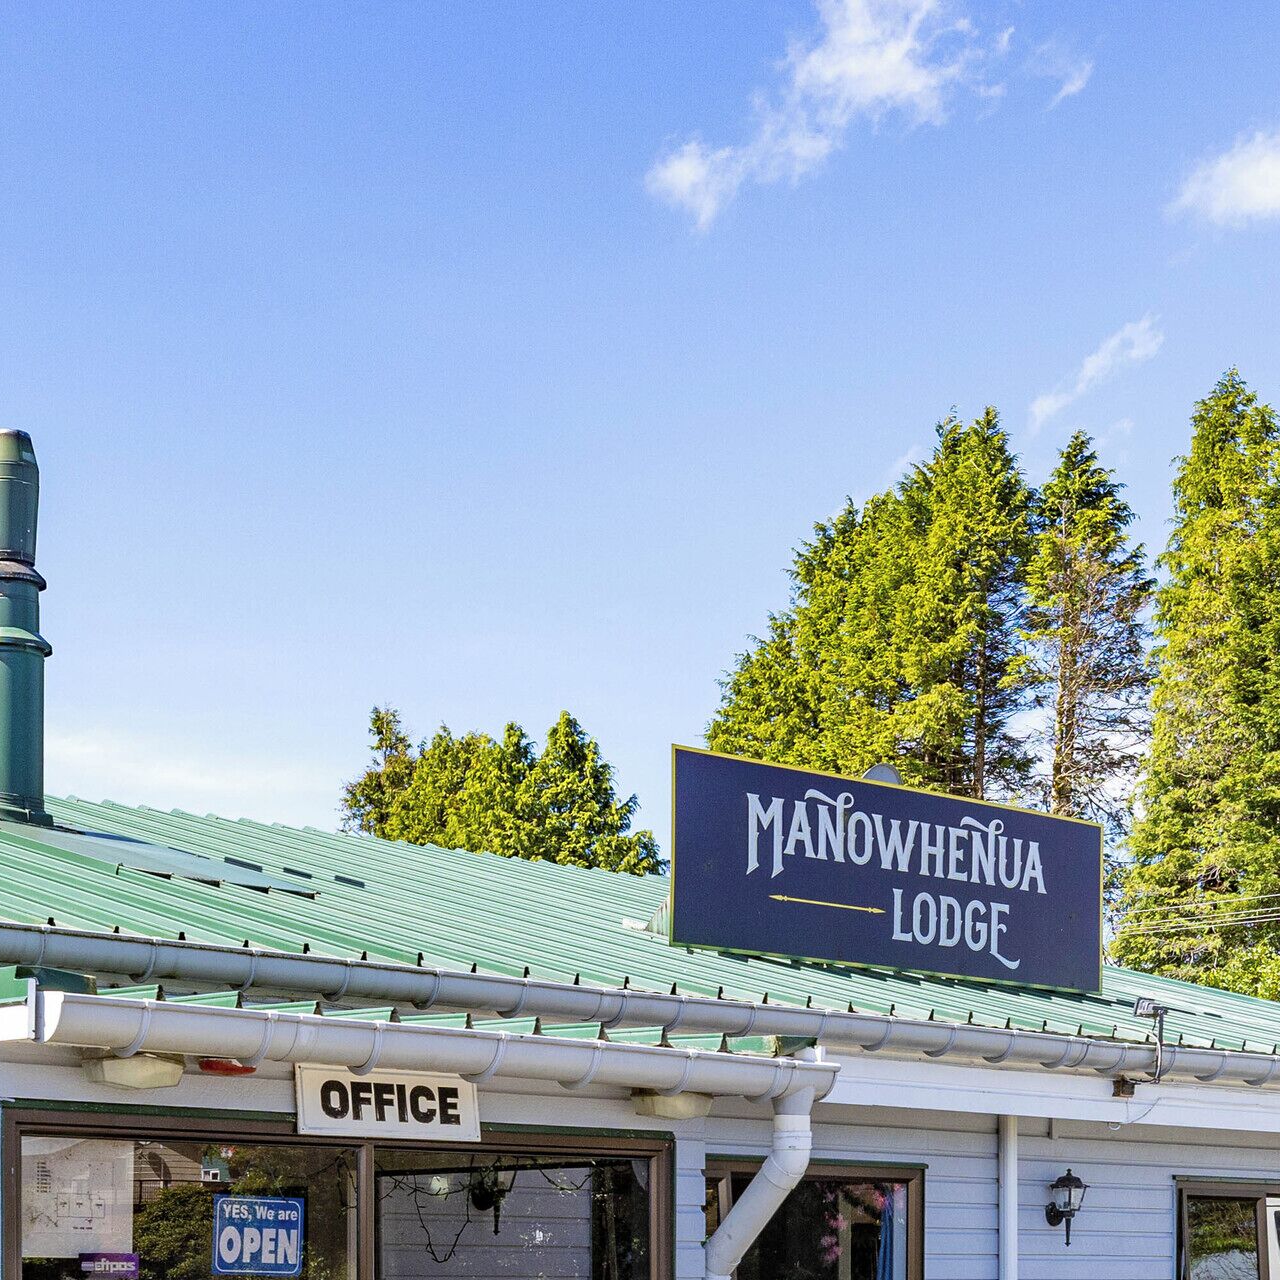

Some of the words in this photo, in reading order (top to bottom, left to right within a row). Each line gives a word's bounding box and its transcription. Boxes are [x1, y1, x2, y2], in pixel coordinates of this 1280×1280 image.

[746, 788, 1047, 895] MANOWHENUA
[891, 888, 1020, 970] LODGE
[320, 1079, 461, 1125] OFFICE
[223, 1204, 252, 1222] YES,
[255, 1206, 273, 1220] We
[277, 1210, 298, 1221] are
[220, 1225, 297, 1264] OPEN
